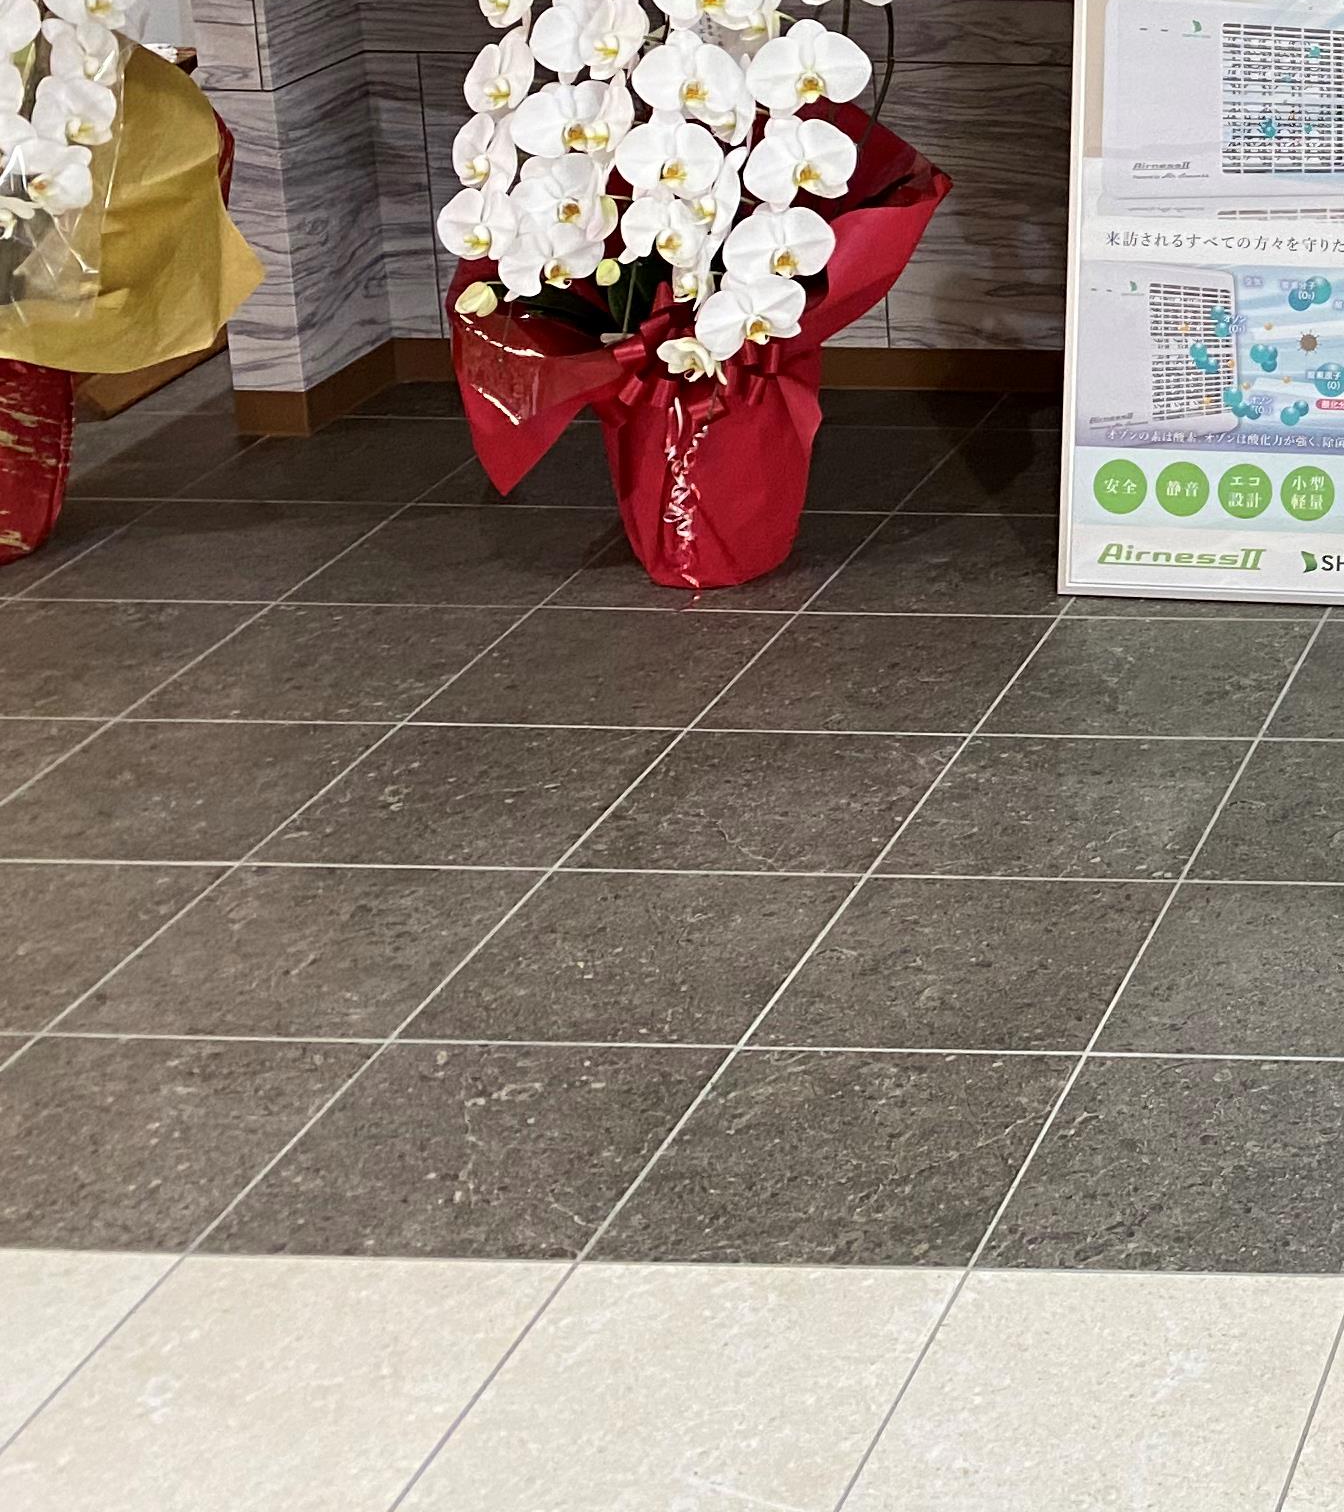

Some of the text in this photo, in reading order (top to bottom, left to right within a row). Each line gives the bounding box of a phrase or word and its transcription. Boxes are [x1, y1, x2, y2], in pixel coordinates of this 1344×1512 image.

[1103, 478, 1138, 495] 安全
[1166, 480, 1200, 497] 静音
[1229, 476, 1261, 486] エコ
[1291, 475, 1325, 492] 小型
[1228, 492, 1262, 508] 設計
[1290, 493, 1324, 510] 軽量
